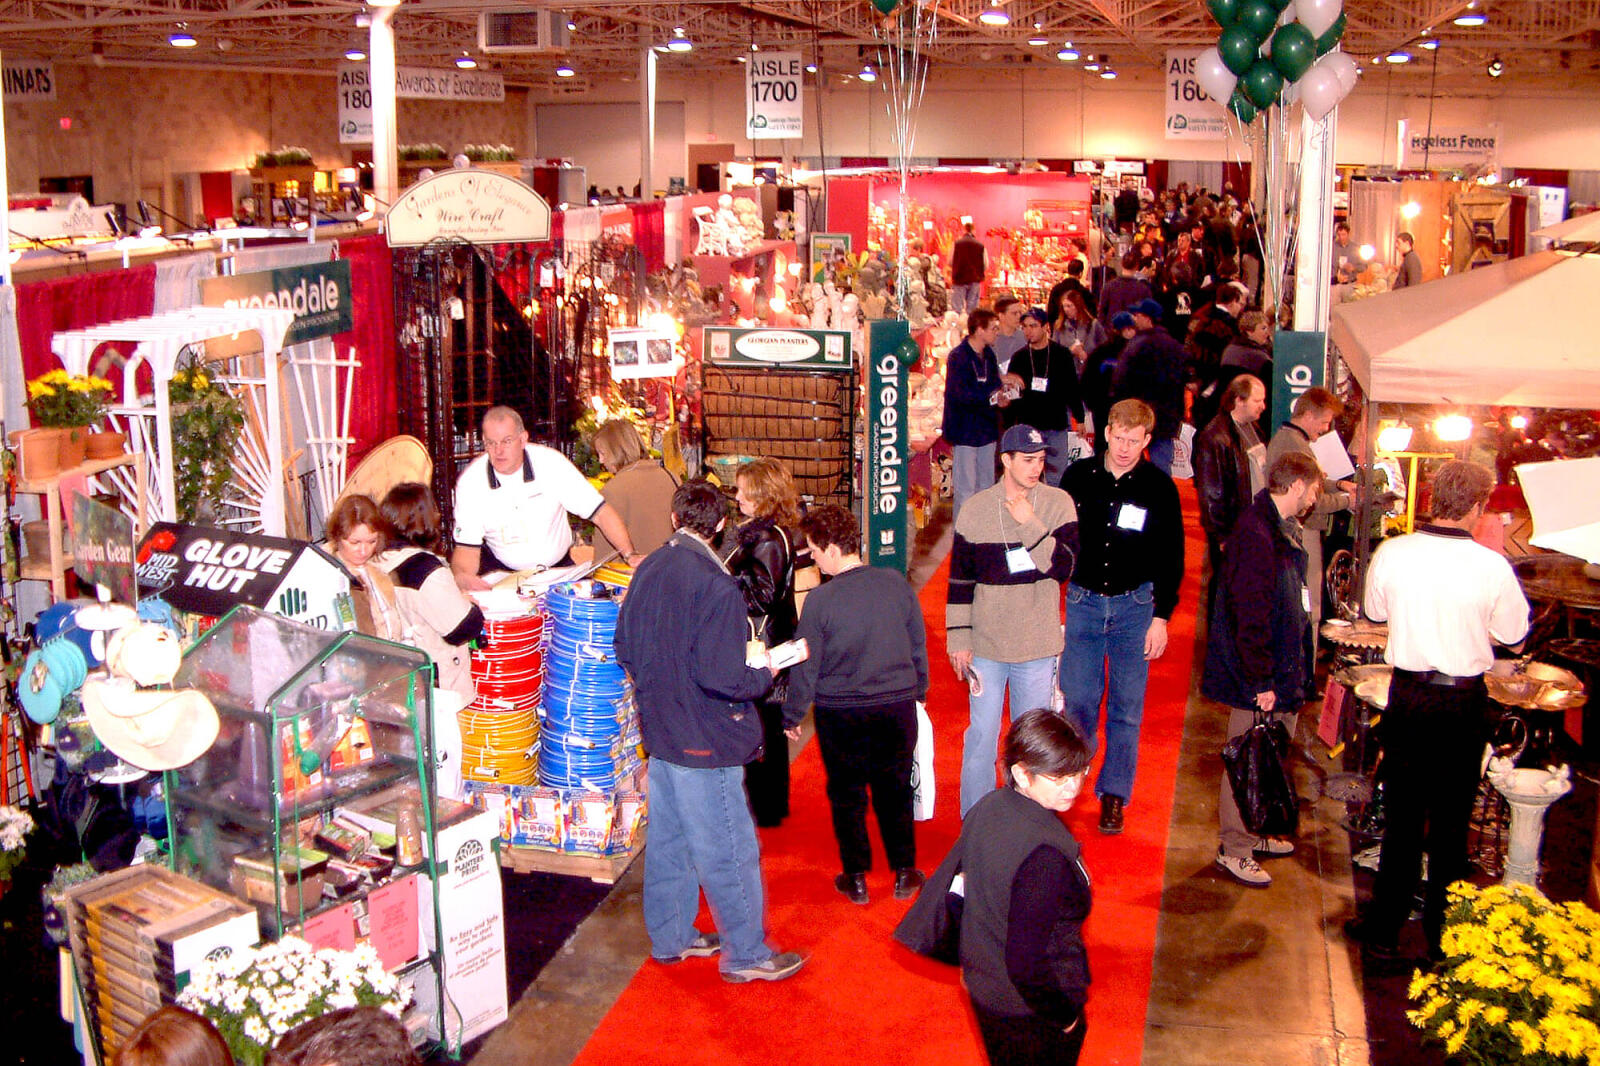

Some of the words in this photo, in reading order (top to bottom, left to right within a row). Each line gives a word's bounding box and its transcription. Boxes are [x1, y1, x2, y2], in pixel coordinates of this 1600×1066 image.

[751, 60, 800, 76] AISLE
[1169, 57, 1197, 75] AIS
[340, 71, 371, 86] AISL
[397, 71, 436, 93] Awards
[438, 74, 450, 93] of
[453, 74, 502, 98] Excellence
[342, 89, 372, 109] 180
[753, 81, 798, 102] 1700
[1171, 79, 1217, 102] 160
[1460, 134, 1495, 149] Fence
[405, 184, 456, 218] Gardens
[459, 176, 481, 196] Of
[436, 208, 463, 223] Wire
[470, 208, 505, 226] Craft
[876, 354, 902, 514] greendale
[106, 539, 131, 562] Gear
[146, 552, 178, 568] MID
[183, 538, 293, 575] GLOVE
[136, 563, 179, 581] WEST
[183, 564, 258, 594] HUT
[455, 854, 485, 874] PLANTERS
[461, 864, 480, 878] PRIDE
